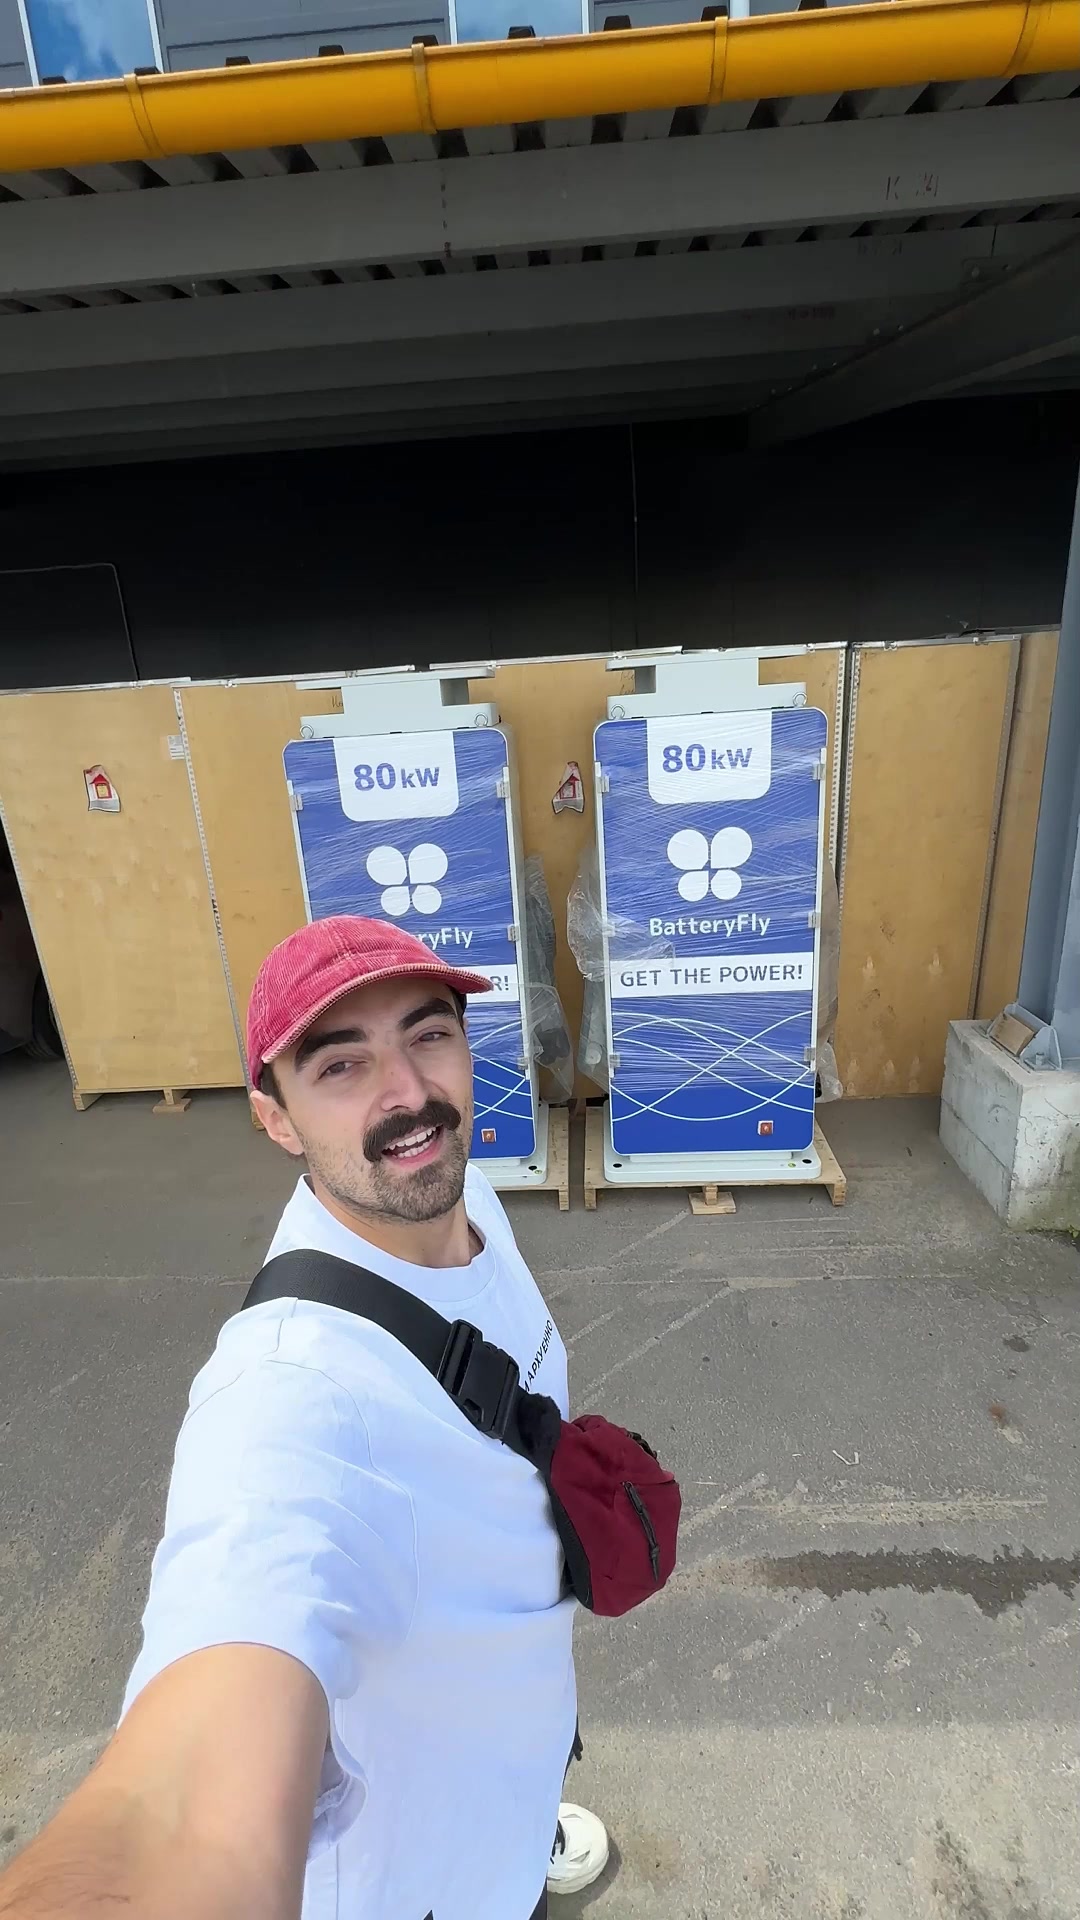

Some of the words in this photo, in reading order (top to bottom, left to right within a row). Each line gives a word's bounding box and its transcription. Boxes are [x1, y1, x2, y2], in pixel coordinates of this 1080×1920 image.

[662, 743, 706, 773] 80
[711, 748, 752, 769] kW
[353, 763, 396, 791] 80
[401, 767, 440, 788] kW
[649, 913, 771, 937] BatteryFly
[620, 970, 662, 987] GET
[670, 967, 712, 985] THE
[719, 964, 803, 983] POWER!
